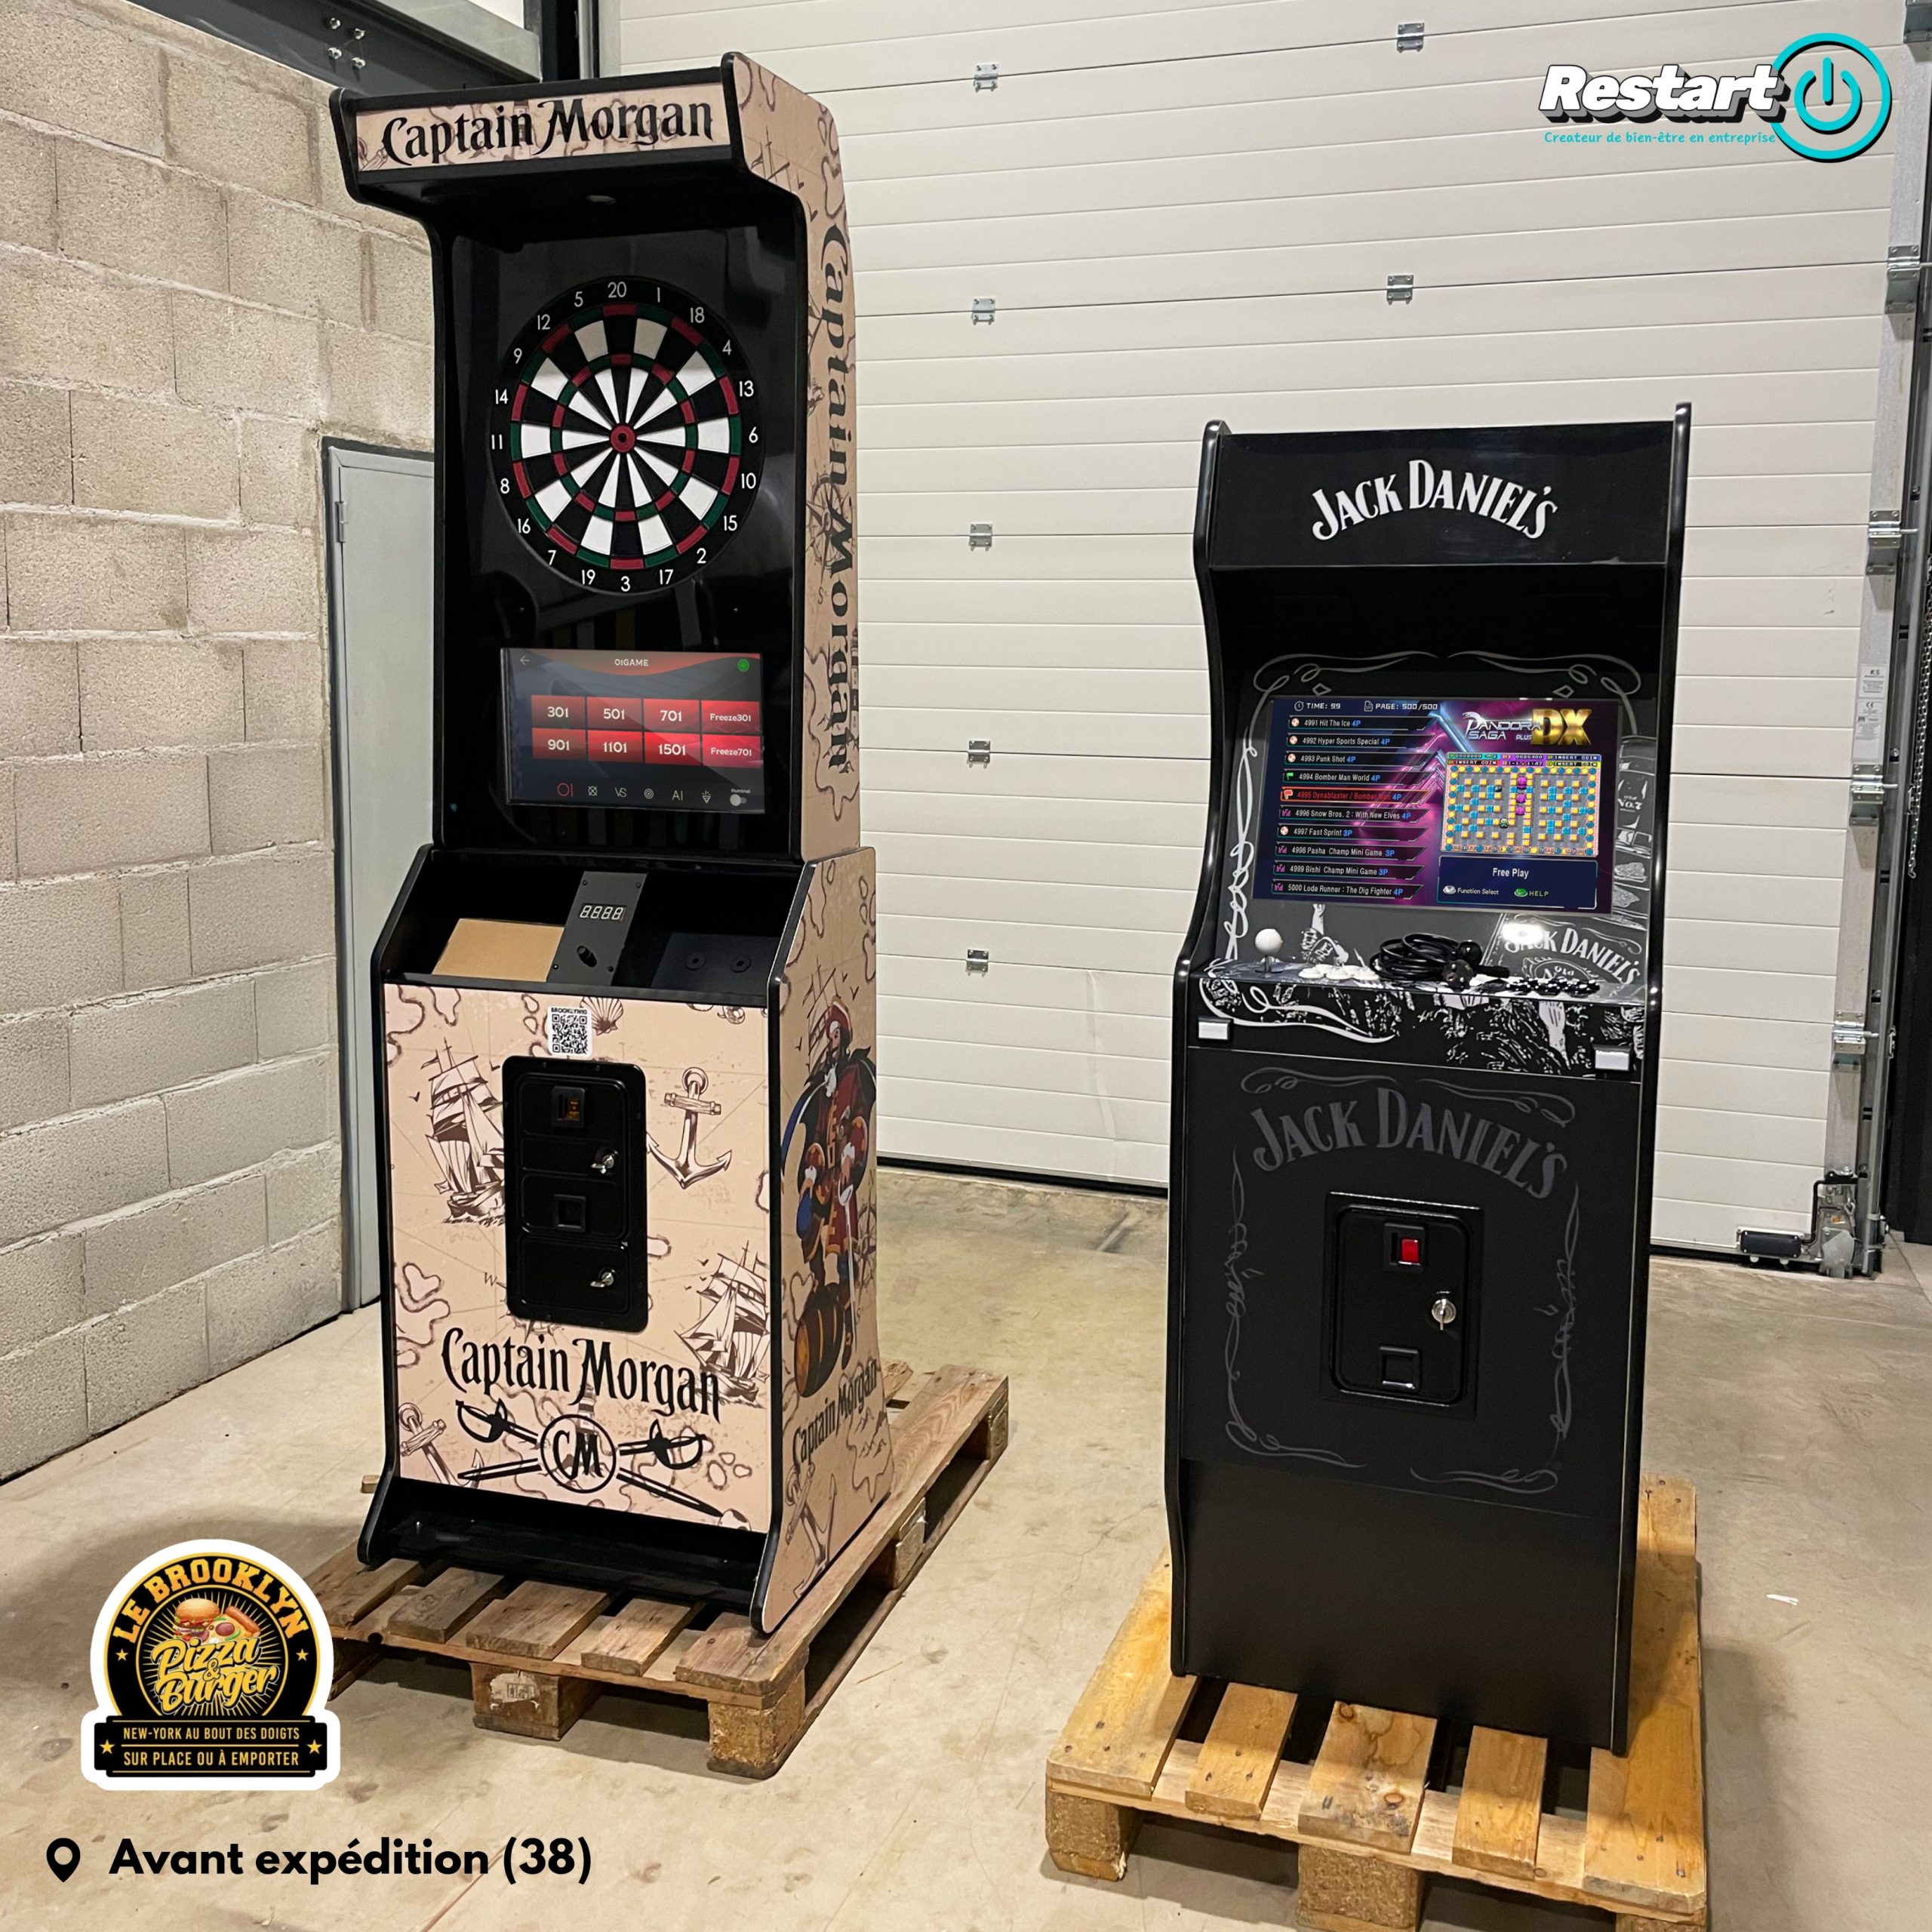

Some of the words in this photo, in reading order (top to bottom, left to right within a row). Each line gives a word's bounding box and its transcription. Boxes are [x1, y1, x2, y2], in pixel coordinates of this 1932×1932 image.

[381, 105, 533, 165] Captain
[531, 98, 714, 155] Morgan
[608, 281, 627, 298] 20
[657, 287, 660, 303] 1
[574, 291, 583, 307] 5
[537, 314, 551, 331] 12
[690, 306, 705, 323] 18
[722, 339, 732, 355] 4
[820, 222, 852, 486] Captain
[513, 348, 522, 364] 9
[739, 380, 754, 397] 13
[495, 389, 509, 405] 14
[491, 434, 503, 450] 11
[749, 426, 758, 443] 6
[500, 478, 510, 494] 8
[741, 472, 756, 489] 10
[1312, 473, 1403, 540] JACK
[518, 518, 531, 534] 16
[723, 515, 738, 531] 15
[547, 549, 557, 565] 7
[697, 547, 706, 564] 2
[581, 569, 596, 585] 19
[620, 576, 631, 592] 3
[659, 569, 674, 585] 17
[826, 494, 854, 769] Morgan
[547, 706, 568, 718] 301
[603, 708, 625, 720] 501
[660, 709, 682, 721] 701
[709, 713, 752, 722] Freeze301
[1531, 708, 1592, 746] DX
[1318, 737, 1334, 746] Hyper
[1336, 737, 1356, 746] Sports
[1468, 731, 1506, 740] SAGA
[547, 739, 570, 751] 901
[603, 741, 627, 753] 1101
[658, 743, 686, 755] 1501
[711, 747, 752, 756] Freeze701
[614, 788, 627, 798] VS
[1324, 829, 1342, 837] Sprint
[1328, 848, 1349, 857] Champ
[1324, 866, 1344, 875] Champ
[1492, 867, 1510, 877] Free
[1512, 868, 1529, 879] Play
[1346, 886, 1358, 894] The
[1358, 887, 1369, 896] Dig
[1371, 887, 1392, 896] Fighter
[1250, 1100, 1366, 1171] JACK
[441, 1327, 569, 1395] Captain
[572, 1338, 721, 1423] Morgan
[793, 1398, 835, 1472] Captain
[836, 1358, 877, 1437] Morgan
[552, 1430, 603, 1480] CM
